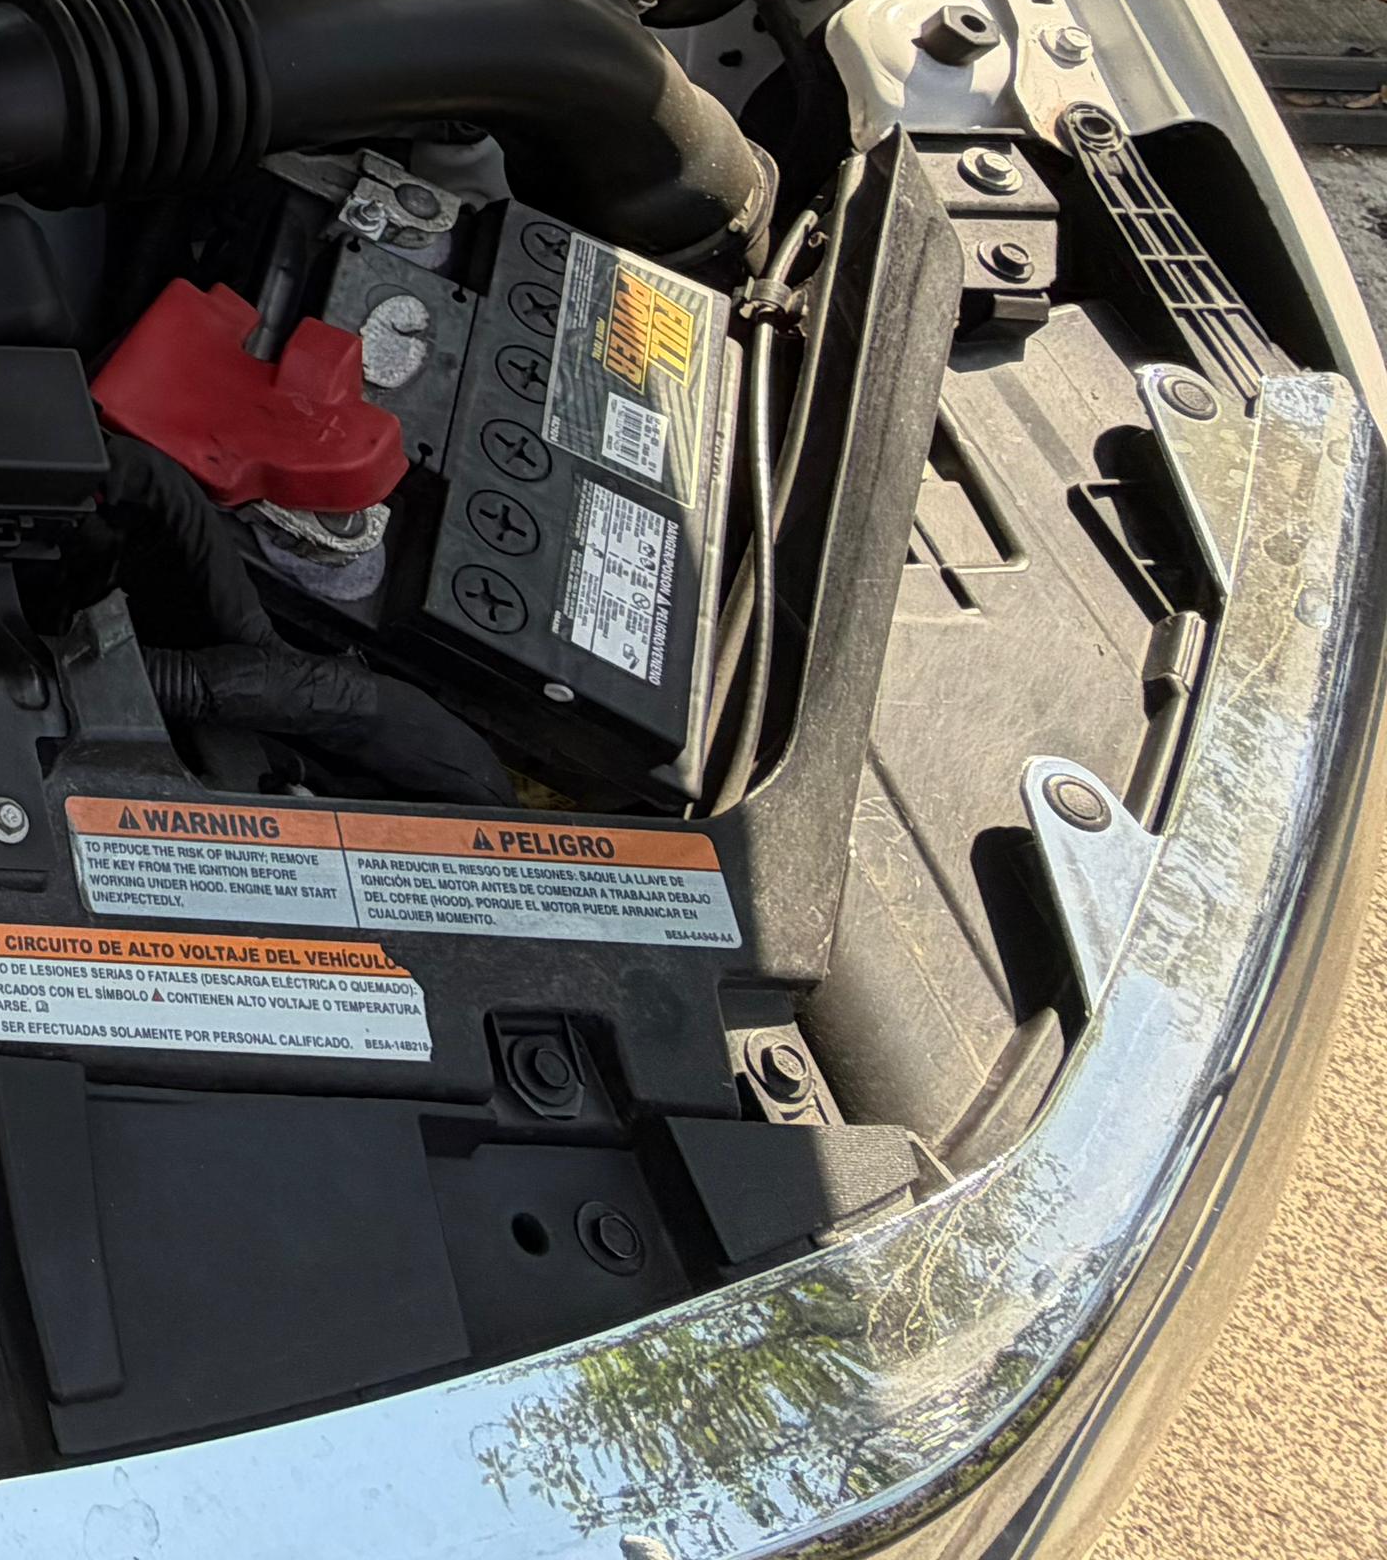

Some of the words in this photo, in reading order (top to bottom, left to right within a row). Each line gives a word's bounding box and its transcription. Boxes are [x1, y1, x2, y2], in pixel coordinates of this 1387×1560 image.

[606, 271, 652, 390] POWER
[649, 292, 690, 384] FULL
[143, 808, 281, 838] WARNING
[85, 841, 101, 854] TO
[102, 842, 150, 857] REDUCE
[152, 845, 175, 858] THE
[177, 846, 204, 860] RISK
[206, 848, 223, 861] OF
[270, 852, 319, 866] REMOVE
[498, 830, 615, 859] PELIGRO
[88, 857, 110, 871] THE
[112, 858, 136, 872] KEY
[138, 860, 171, 874] FROM
[173, 862, 196, 875] THE
[198, 863, 248, 878] IGNITION
[250, 866, 297, 881] BEFORE
[357, 857, 388, 871] PARA
[390, 859, 439, 874] REDUCIR
[442, 862, 456, 874] EL
[458, 863, 500, 877] RIESGO
[502, 865, 518, 878] DE
[579, 870, 616, 884] SAQUE
[618, 872, 633, 885] LA
[634, 873, 667, 887] LLAVE
[669, 875, 685, 888] DE
[89, 874, 145, 889] WORKING
[147, 877, 188, 892] UNDER
[229, 882, 272, 896] ENGINE
[274, 884, 298, 898] MAY
[301, 886, 337, 900] START
[5, 934, 93, 955] CIRCUITO
[99, 940, 123, 956] DE
[129, 942, 175, 959] ALTO
[179, 944, 260, 963] VOLTAJE
[265, 948, 301, 966] DEL
[10, 962, 27, 976] DE
[29, 963, 88, 979] LESIONES
[90, 966, 133, 981] SERIAS
[135, 969, 145, 982] O
[147, 969, 198, 984] FATALES
[200, 972, 270, 988] (DESCARGA
[338, 980, 348, 992] O
[48, 985, 74, 999] CON
[77, 987, 92, 1000] EL
[94, 986, 149, 1003] SÍMBOLO
[167, 991, 234, 1007] CONTIENEN
[236, 995, 267, 1009] ALTO
[268, 996, 320, 1011] VOLTAJE
[322, 999, 332, 1012] O
[334, 1000, 421, 1016] TEMPERATURA
[1, 1020, 25, 1034] SER
[27, 1021, 107, 1038] EFECTUADAS
[109, 1026, 182, 1042] SOLAMENTE
[184, 1029, 210, 1043] POR
[212, 1031, 277, 1046] PERSONAL
[278, 1034, 354, 1050] CALIFICADO.
